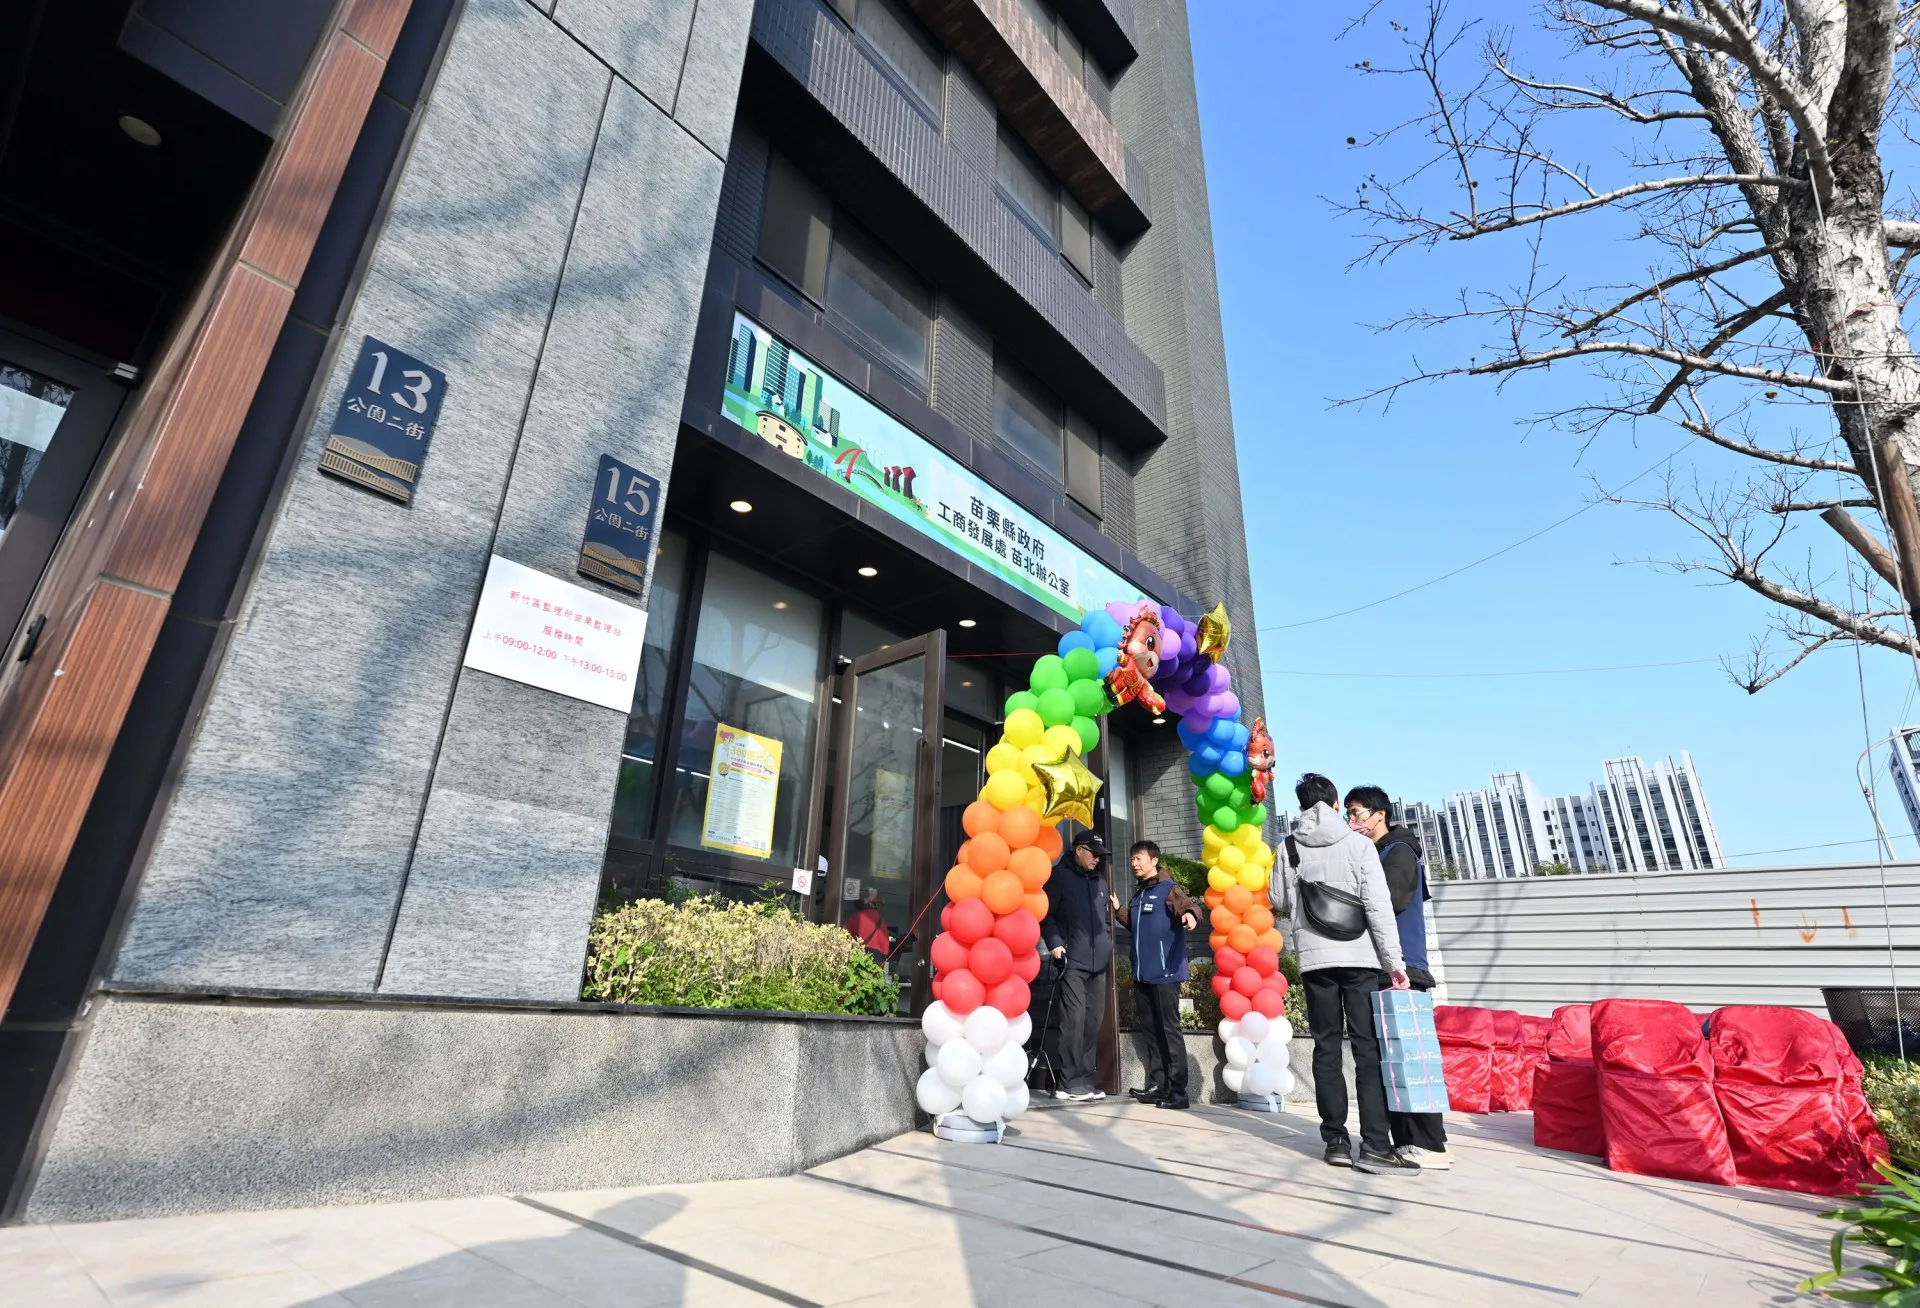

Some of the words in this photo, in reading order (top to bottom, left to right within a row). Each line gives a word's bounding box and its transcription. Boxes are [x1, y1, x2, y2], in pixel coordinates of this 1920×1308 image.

[366, 352, 432, 414] 13
[346, 396, 425, 440] 公園二街
[605, 466, 651, 517] 15
[594, 507, 650, 541] 公園二街
[970, 495, 1045, 561] 苗栗縣政府
[937, 501, 1007, 559] 工商發展處
[1011, 547, 1070, 598] 苗北辦公室
[509, 590, 622, 637] 新竹區監理所苗栗監理站
[543, 625, 584, 647] 服務時間
